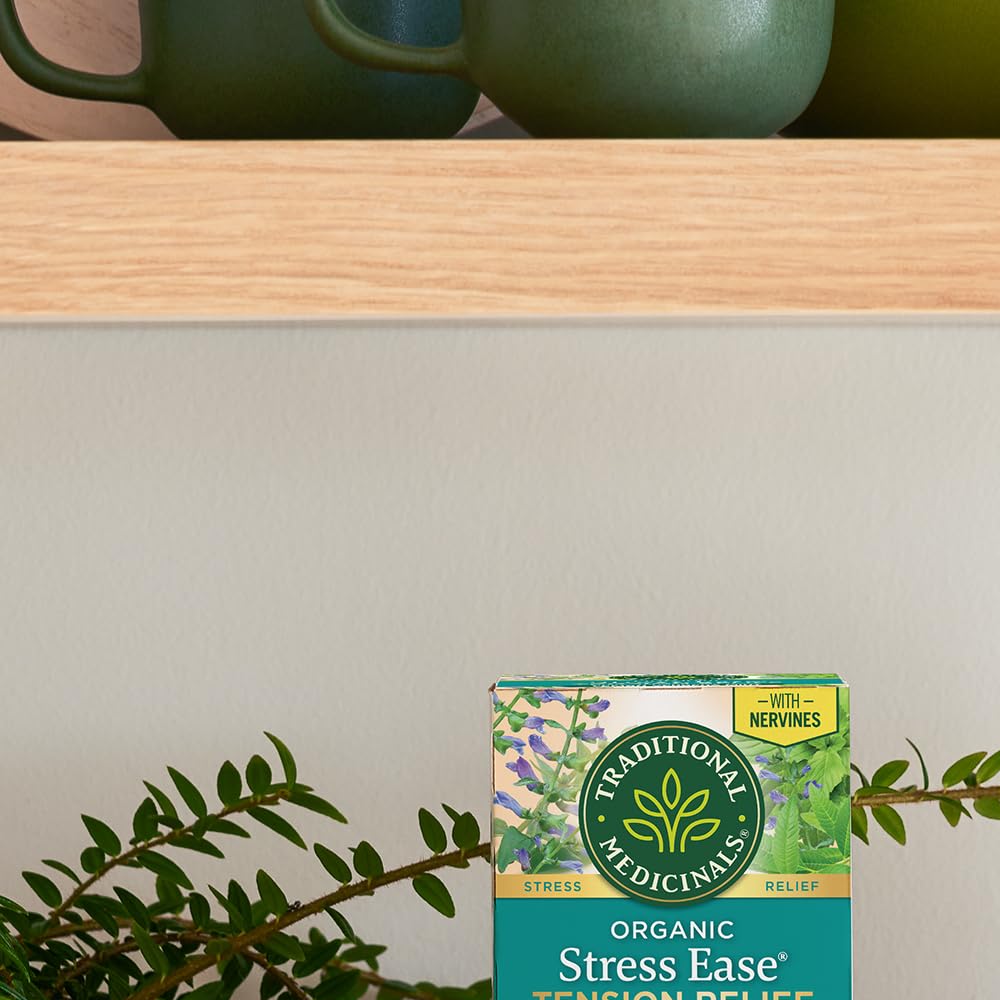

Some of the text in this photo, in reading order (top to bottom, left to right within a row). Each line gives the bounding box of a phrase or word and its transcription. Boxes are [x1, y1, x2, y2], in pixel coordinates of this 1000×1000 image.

[770, 693, 800, 708] WITH
[750, 712, 821, 728] NERVINES
[595, 735, 747, 803] TRADITIONAL
[524, 881, 582, 892] STRESS
[765, 881, 819, 892] RELIEF
[610, 920, 734, 939] ORGANIC
[559, 947, 676, 982] Stress
